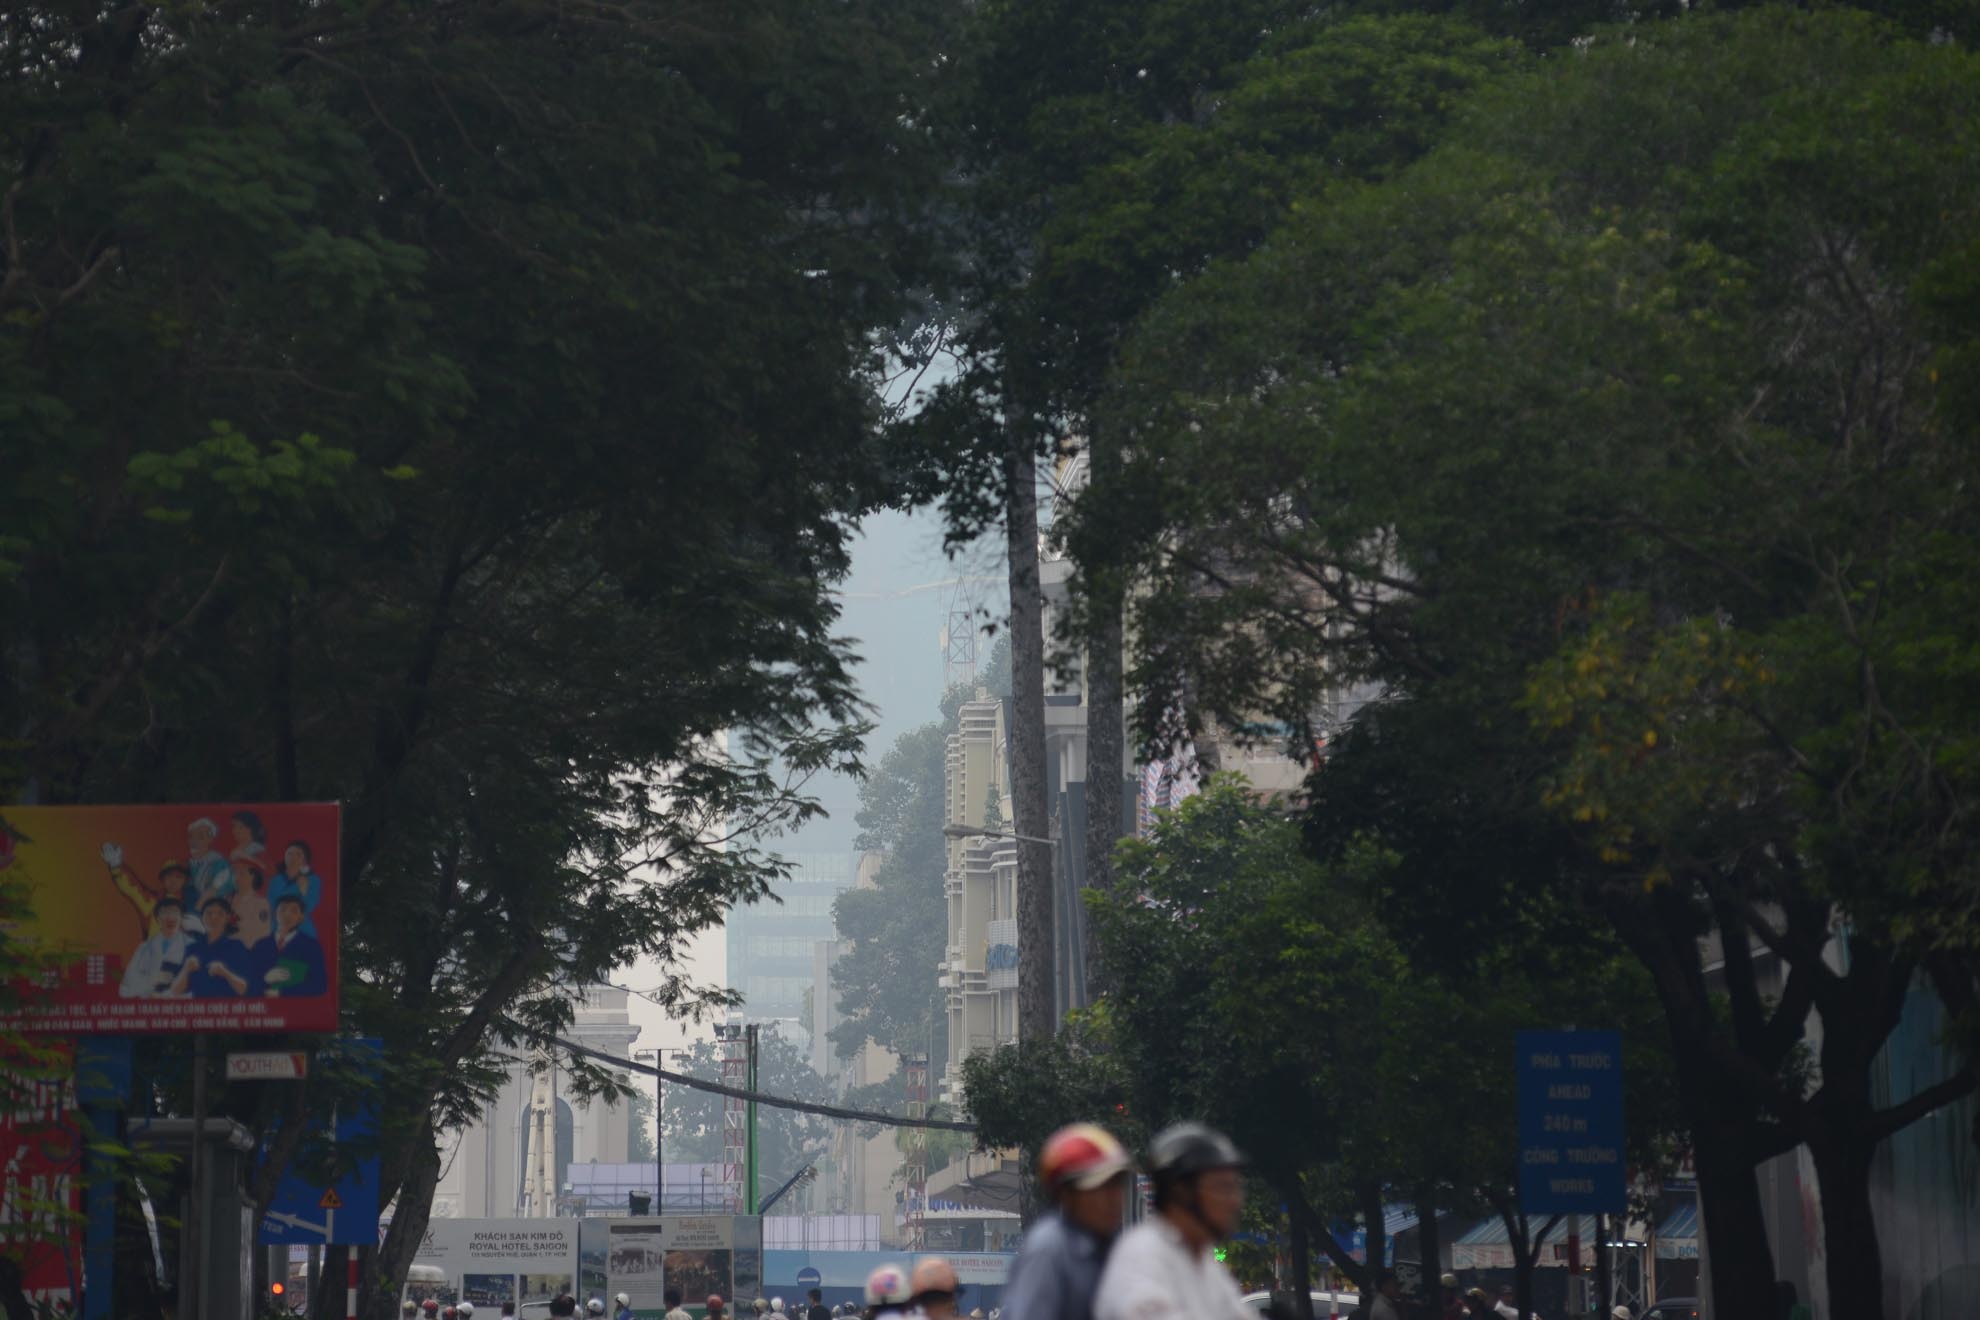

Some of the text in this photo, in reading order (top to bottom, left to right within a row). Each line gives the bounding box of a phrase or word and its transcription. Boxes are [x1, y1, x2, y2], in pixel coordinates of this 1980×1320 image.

[1548, 1084, 1591, 1100] AHEAD
[1550, 1178, 1594, 1195] WORKS
[474, 1231, 506, 1241] KHÁCH
[509, 1232, 528, 1242] SẠN
[530, 1232, 547, 1241] KIM
[469, 1243, 568, 1251] ROYAL HOTEL SAIGON
